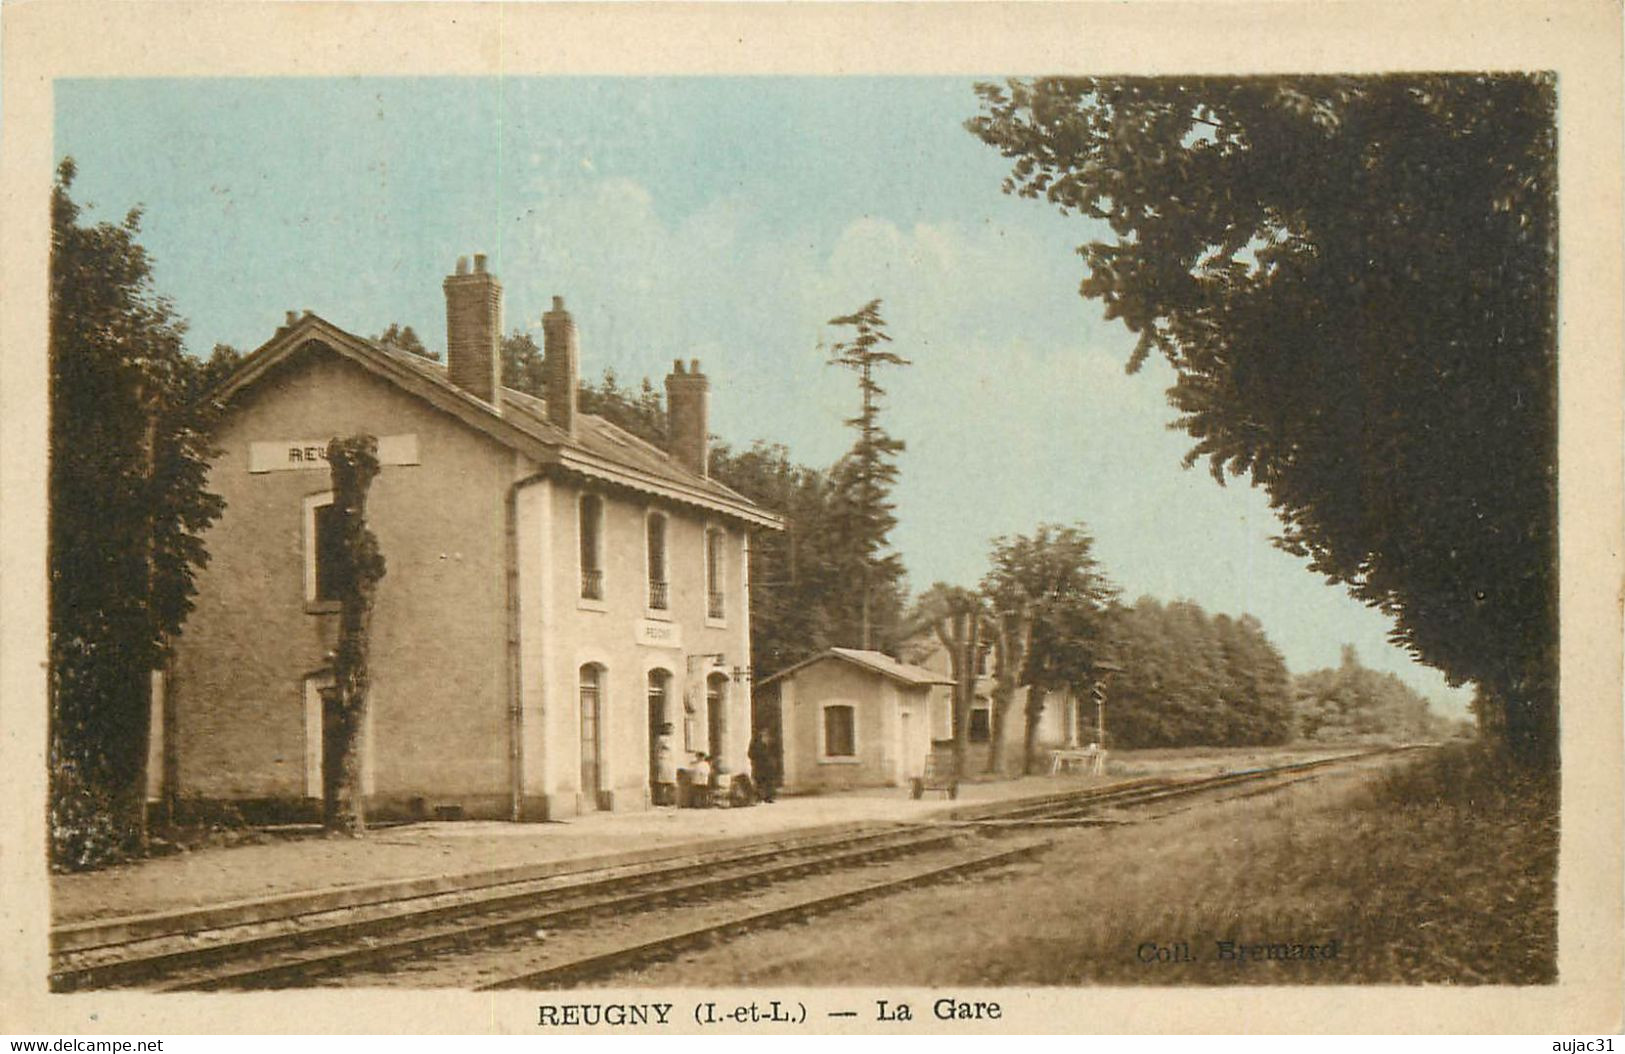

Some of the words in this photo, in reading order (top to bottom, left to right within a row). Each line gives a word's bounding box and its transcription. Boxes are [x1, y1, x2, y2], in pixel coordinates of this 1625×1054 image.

[1137, 942, 1197, 963] Coll.
[538, 1004, 673, 1026] REUGNY
[694, 1002, 807, 1025] (I.-et-L.)
[876, 1000, 913, 1022] La
[933, 998, 1002, 1020] Gare
